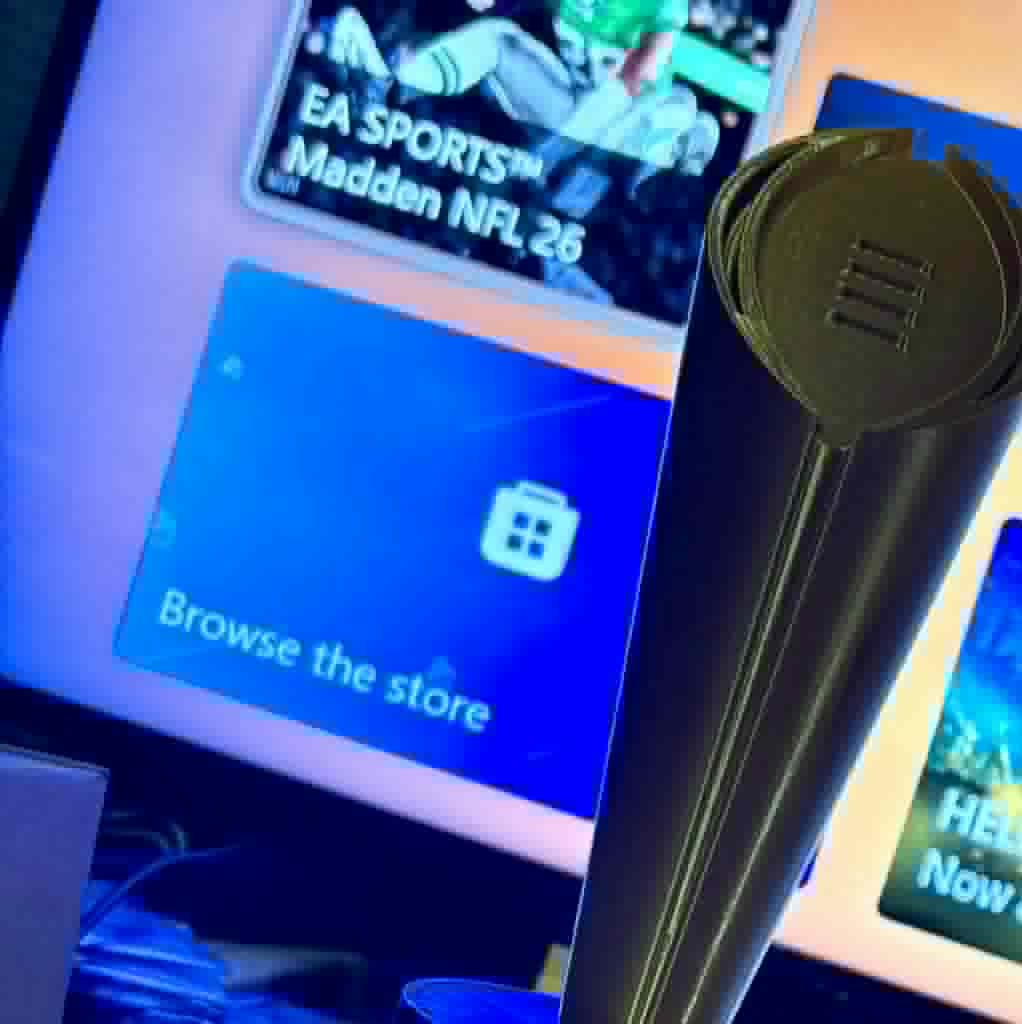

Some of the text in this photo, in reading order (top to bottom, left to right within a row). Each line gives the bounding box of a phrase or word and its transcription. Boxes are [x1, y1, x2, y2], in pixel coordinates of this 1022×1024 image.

[303, 83, 351, 135] EA
[287, 136, 587, 264] Madden NFL 26
[160, 588, 492, 733] Browse the store
[917, 847, 1016, 915] Now
